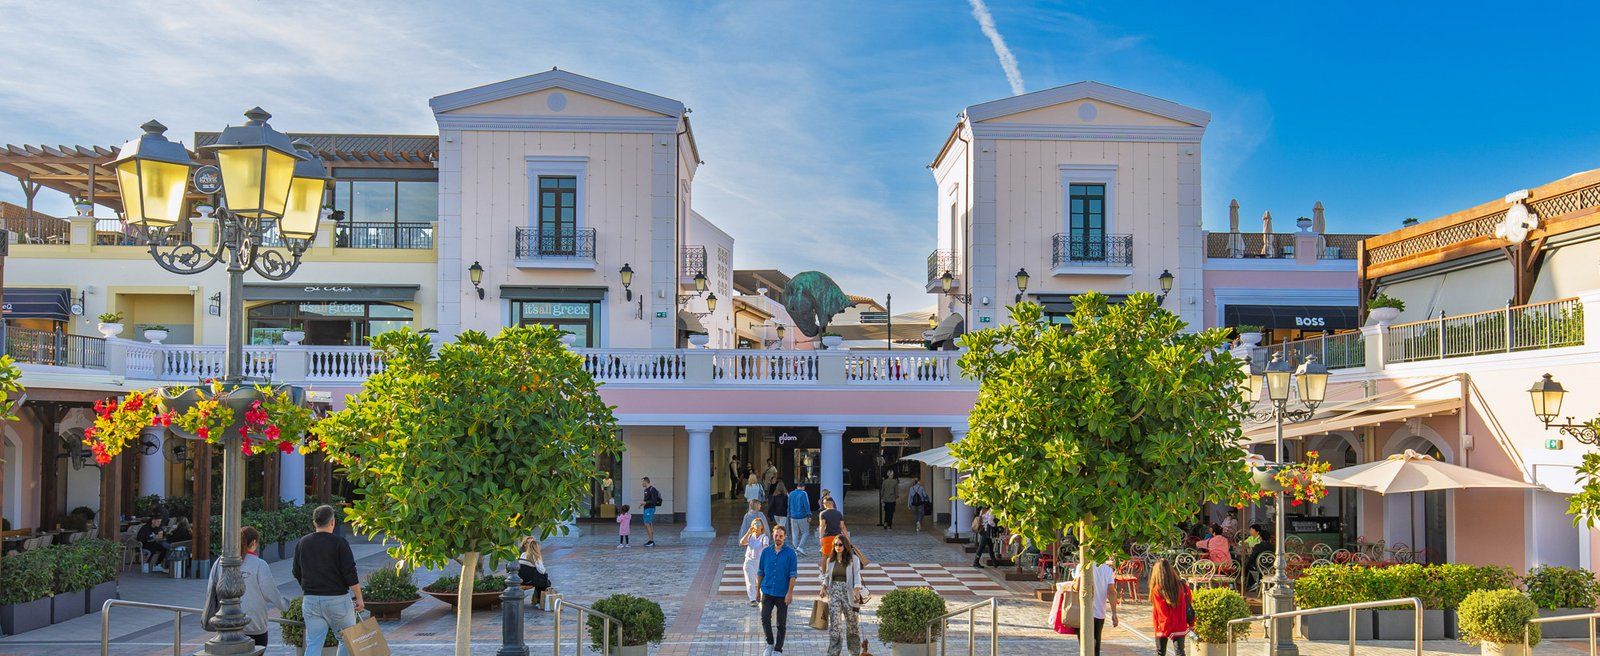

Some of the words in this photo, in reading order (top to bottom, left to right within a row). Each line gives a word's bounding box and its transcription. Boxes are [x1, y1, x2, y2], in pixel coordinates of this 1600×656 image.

[329, 301, 364, 315] greek
[525, 303, 538, 315] it's
[552, 303, 589, 317] greek
[1295, 316, 1326, 327] BOSS
[778, 432, 798, 445] ploom
